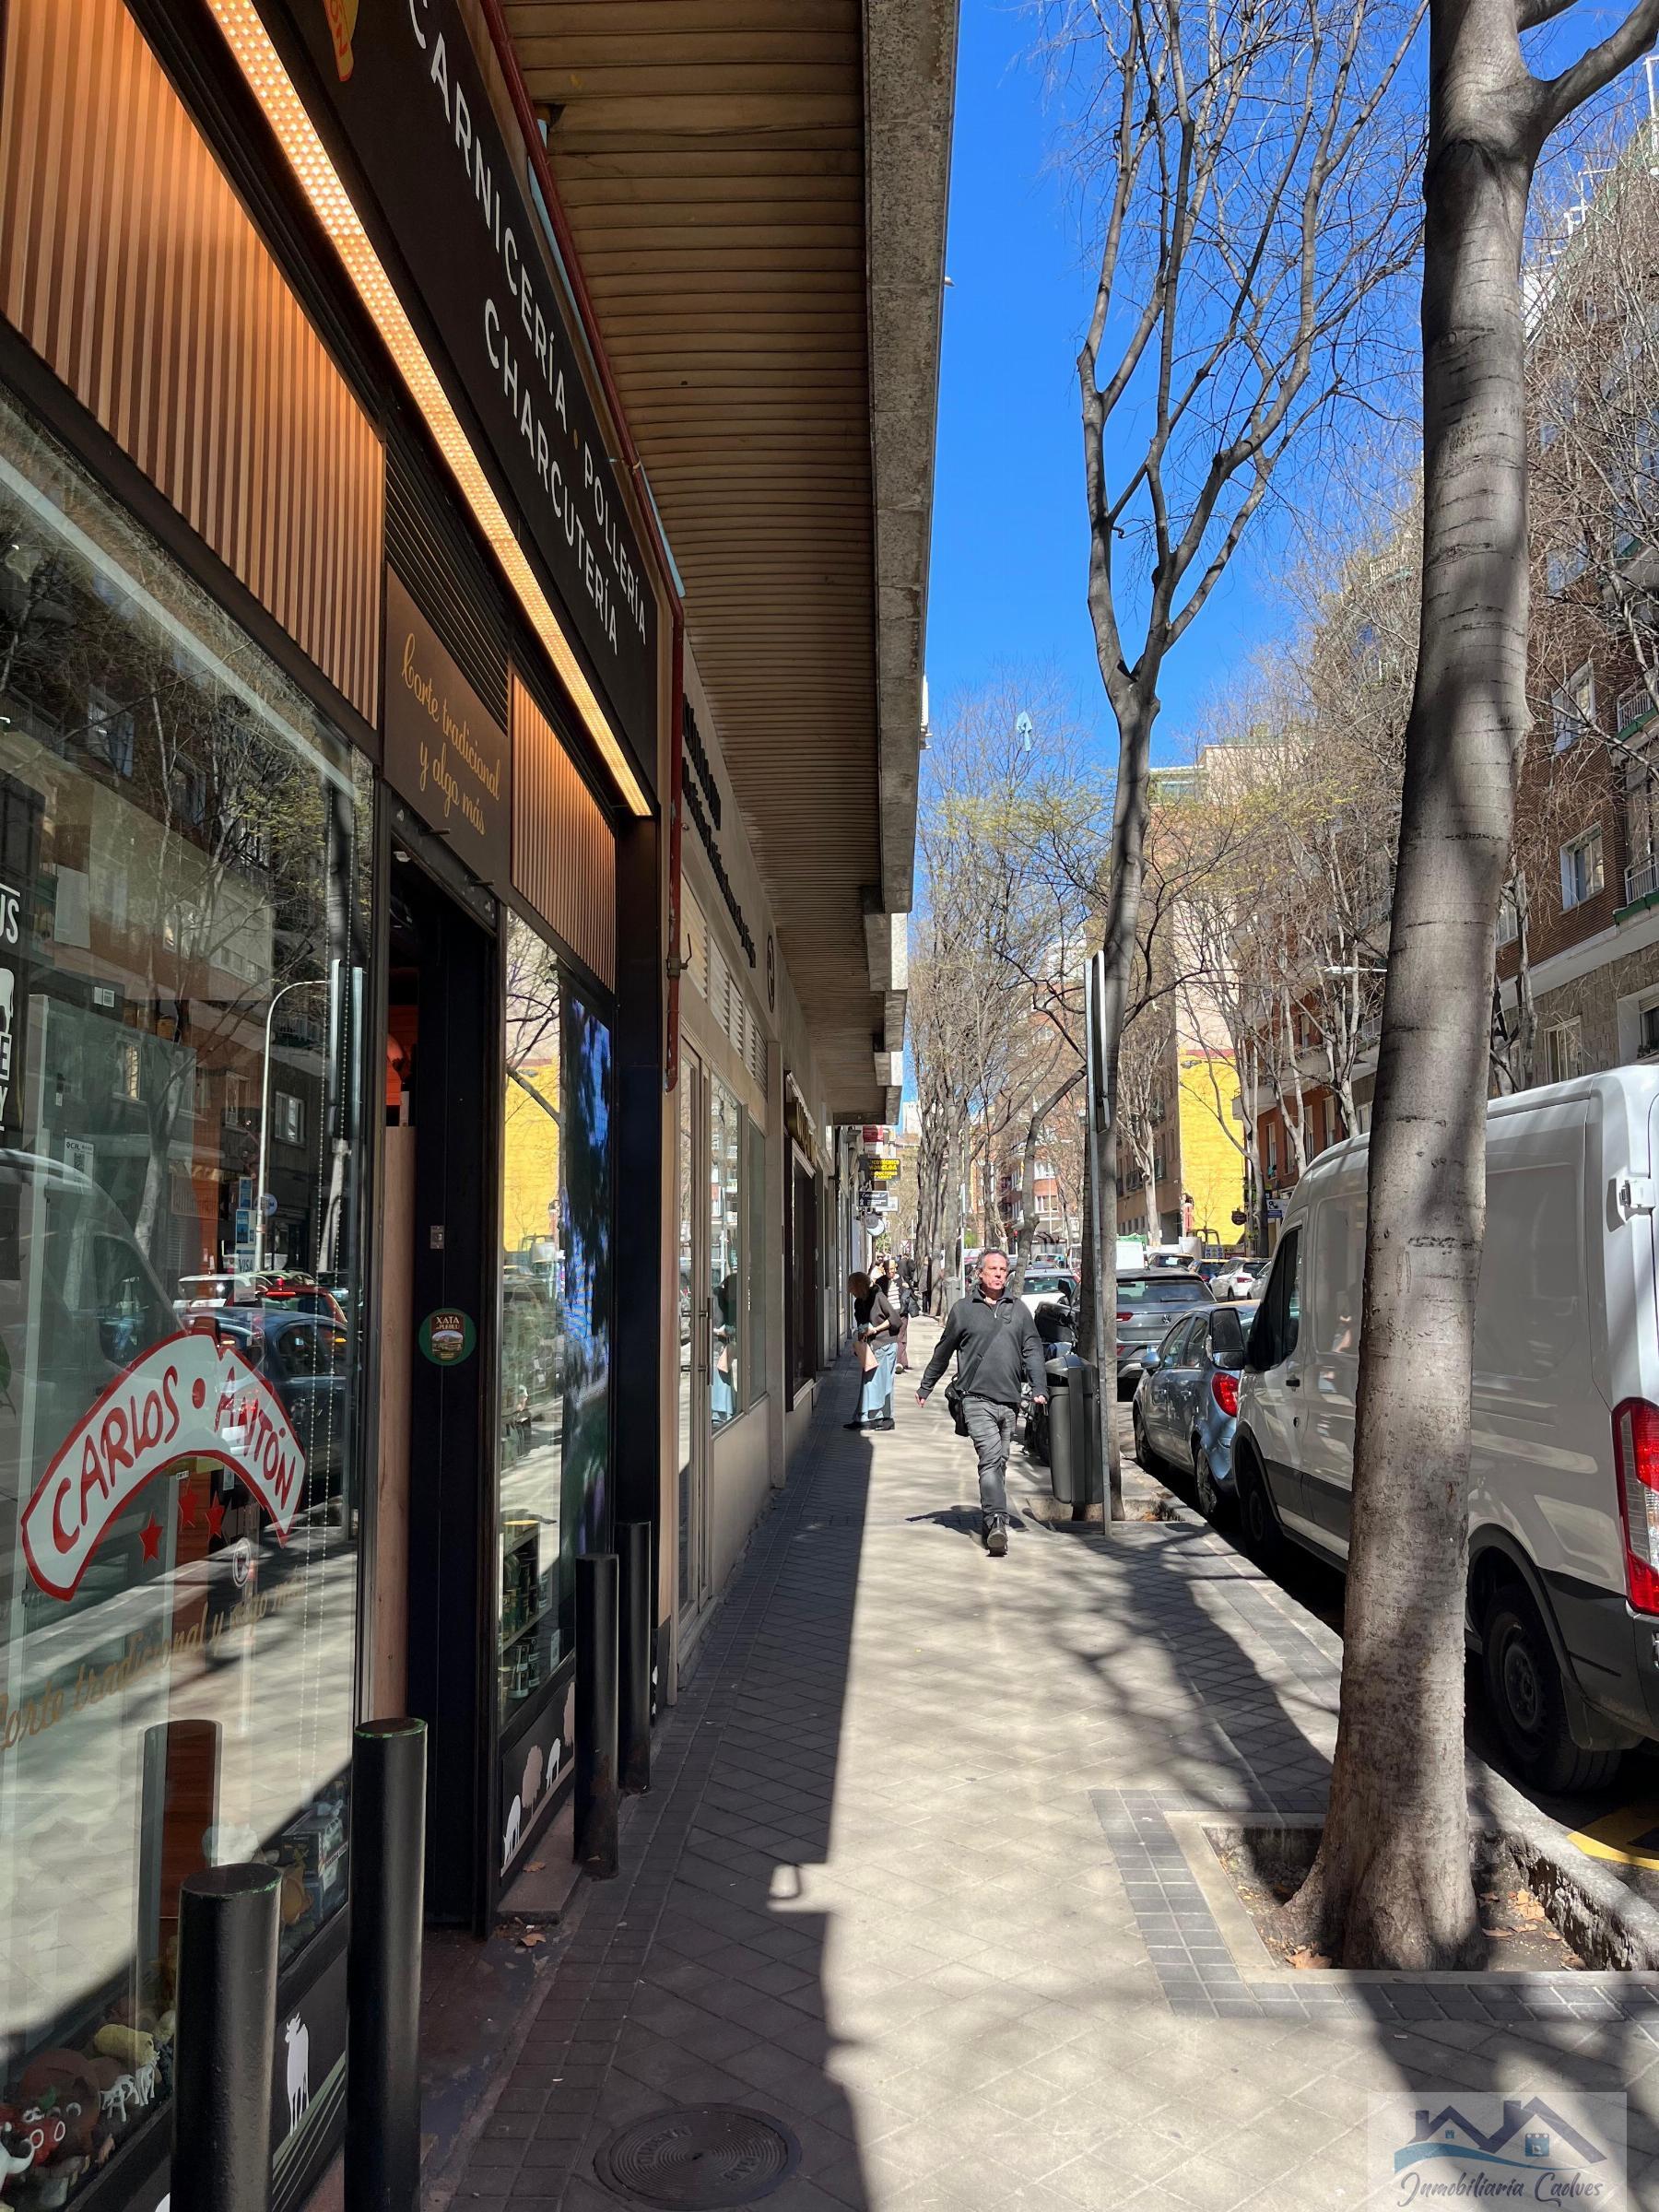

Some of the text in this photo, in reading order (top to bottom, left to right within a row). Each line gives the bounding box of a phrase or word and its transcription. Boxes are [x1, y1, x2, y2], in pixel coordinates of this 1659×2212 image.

[485, 299, 618, 655] CHARCUTERÍA
[584, 441, 646, 645] POLLERÍA
[402, 633, 500, 801] Corte tradicional
[420, 741, 486, 835] y algo más
[53, 1365, 296, 1555] CARLOS ANTÓN
[74, 1600, 209, 1713] tradicional
